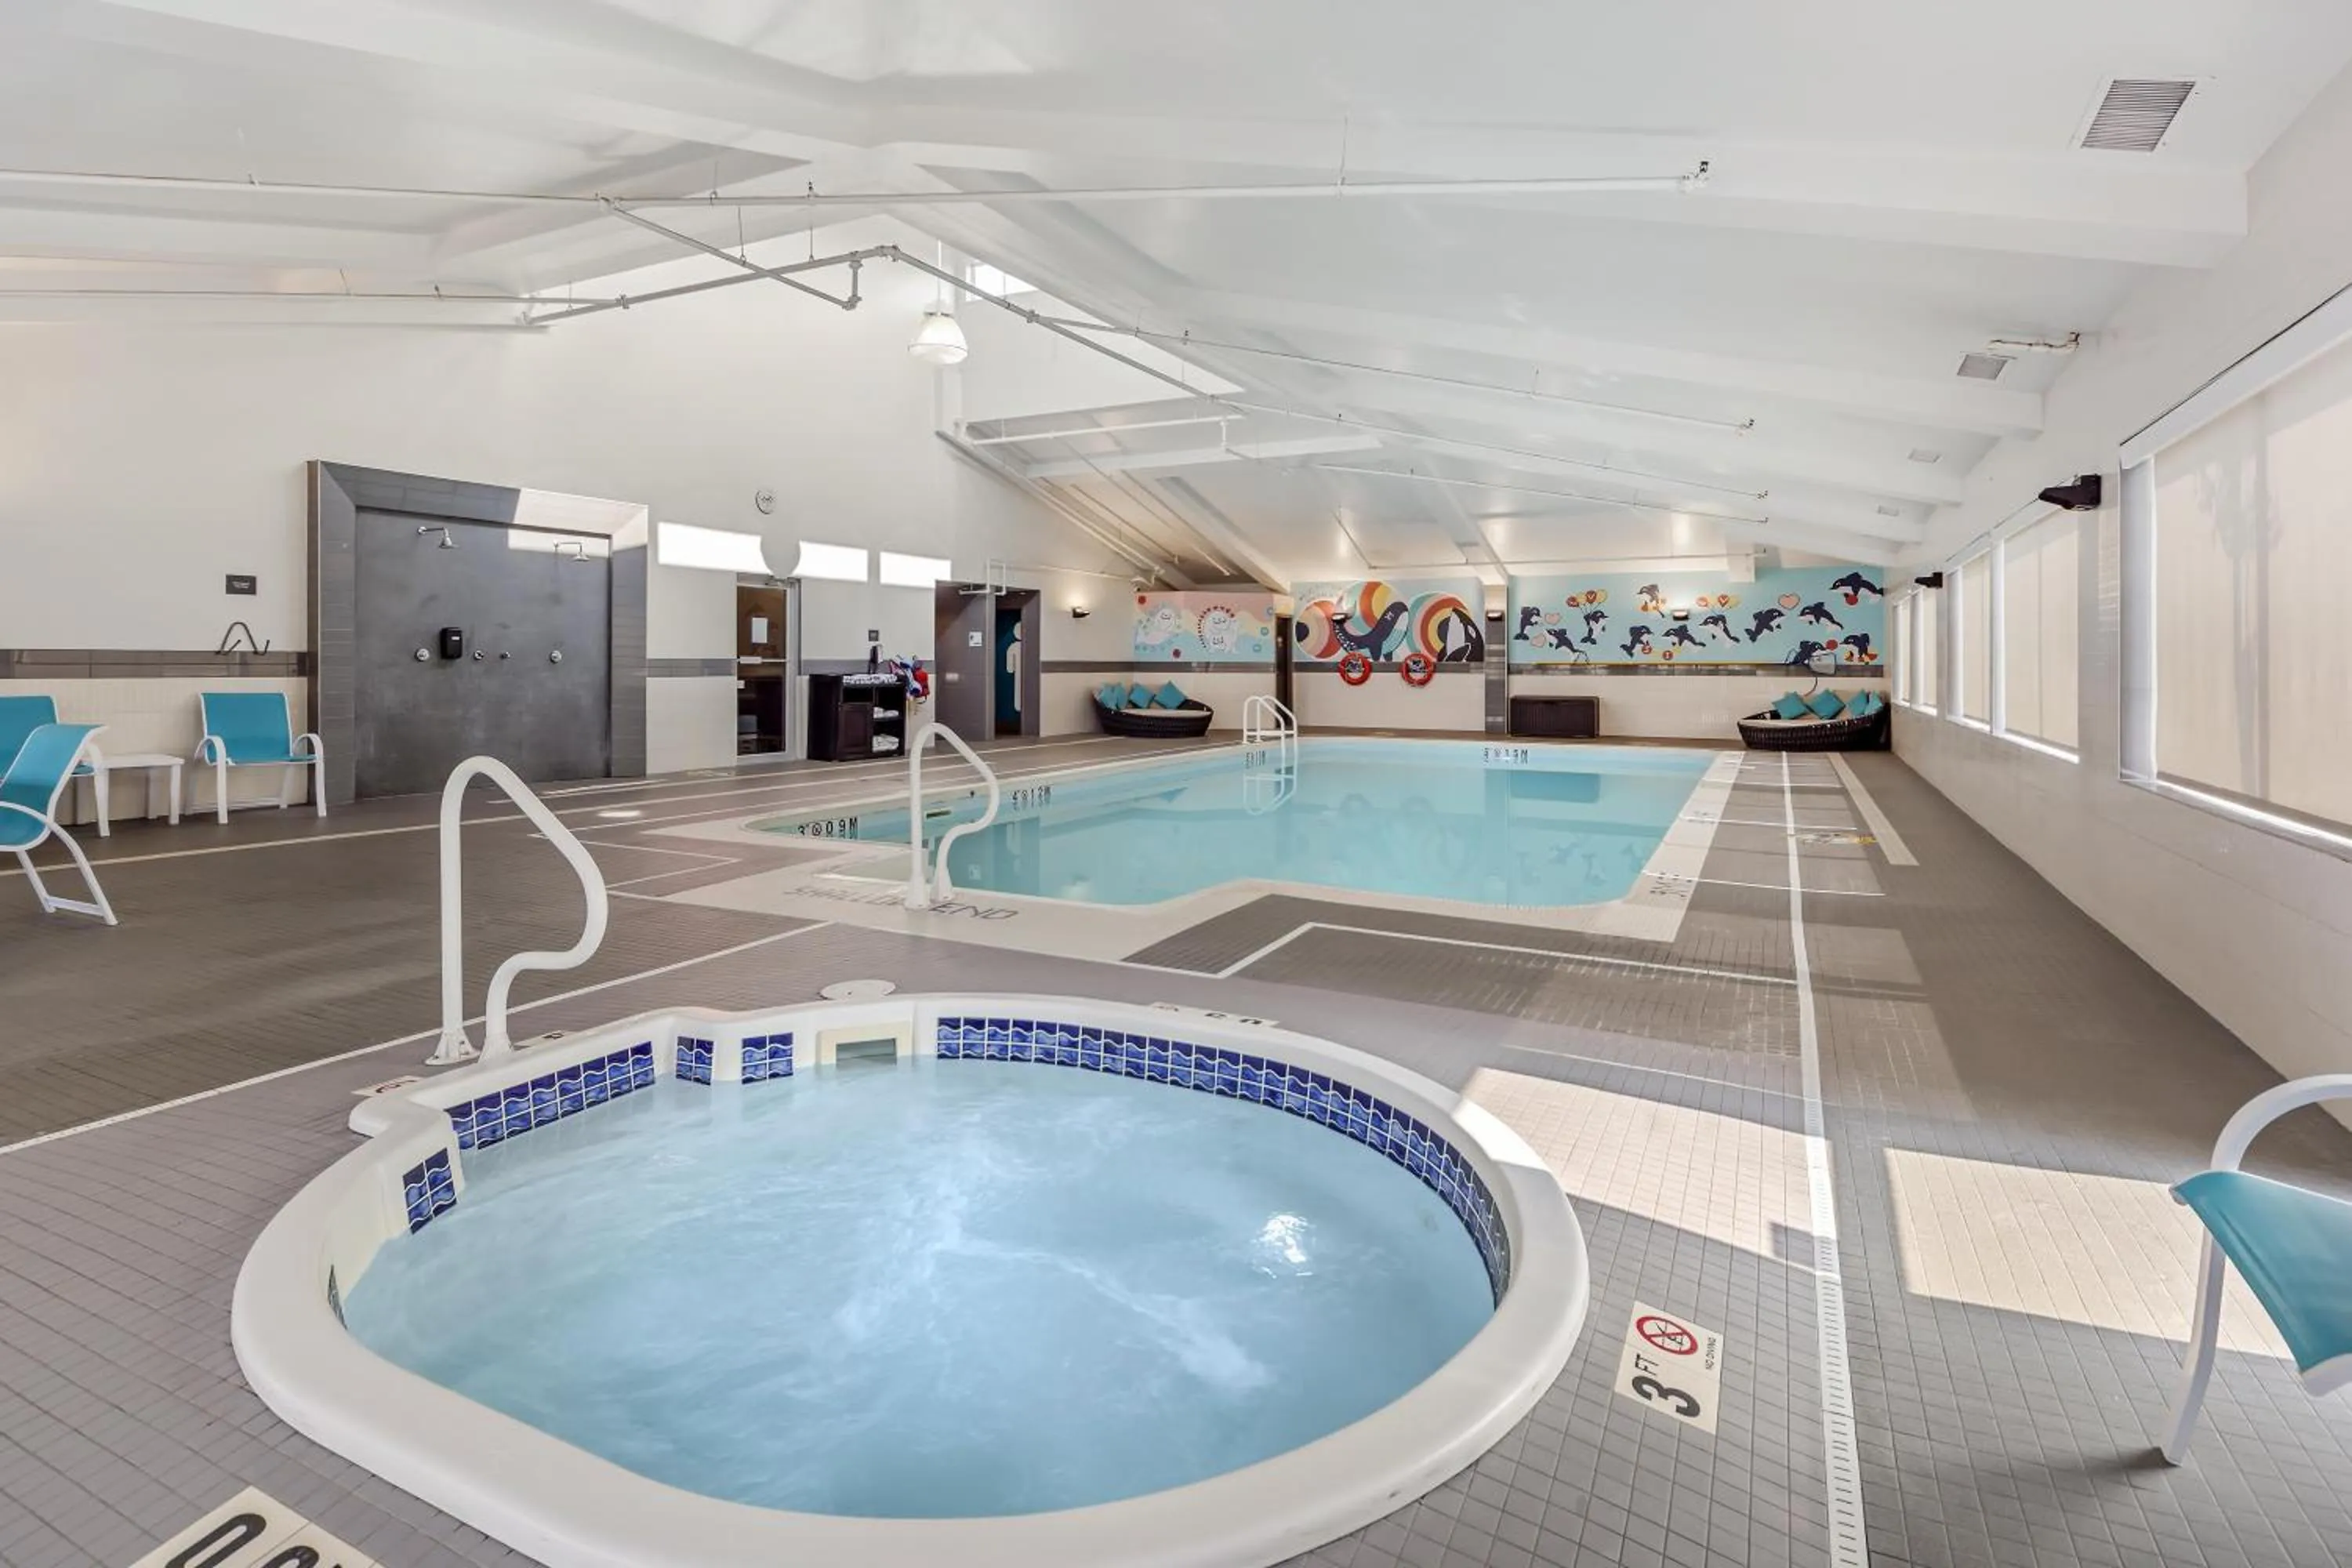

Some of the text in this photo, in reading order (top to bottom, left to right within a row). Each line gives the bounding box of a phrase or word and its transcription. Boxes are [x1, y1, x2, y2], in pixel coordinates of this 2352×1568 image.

[928, 902, 1018, 920] END
[1632, 1352, 1701, 1418] 3 FT
